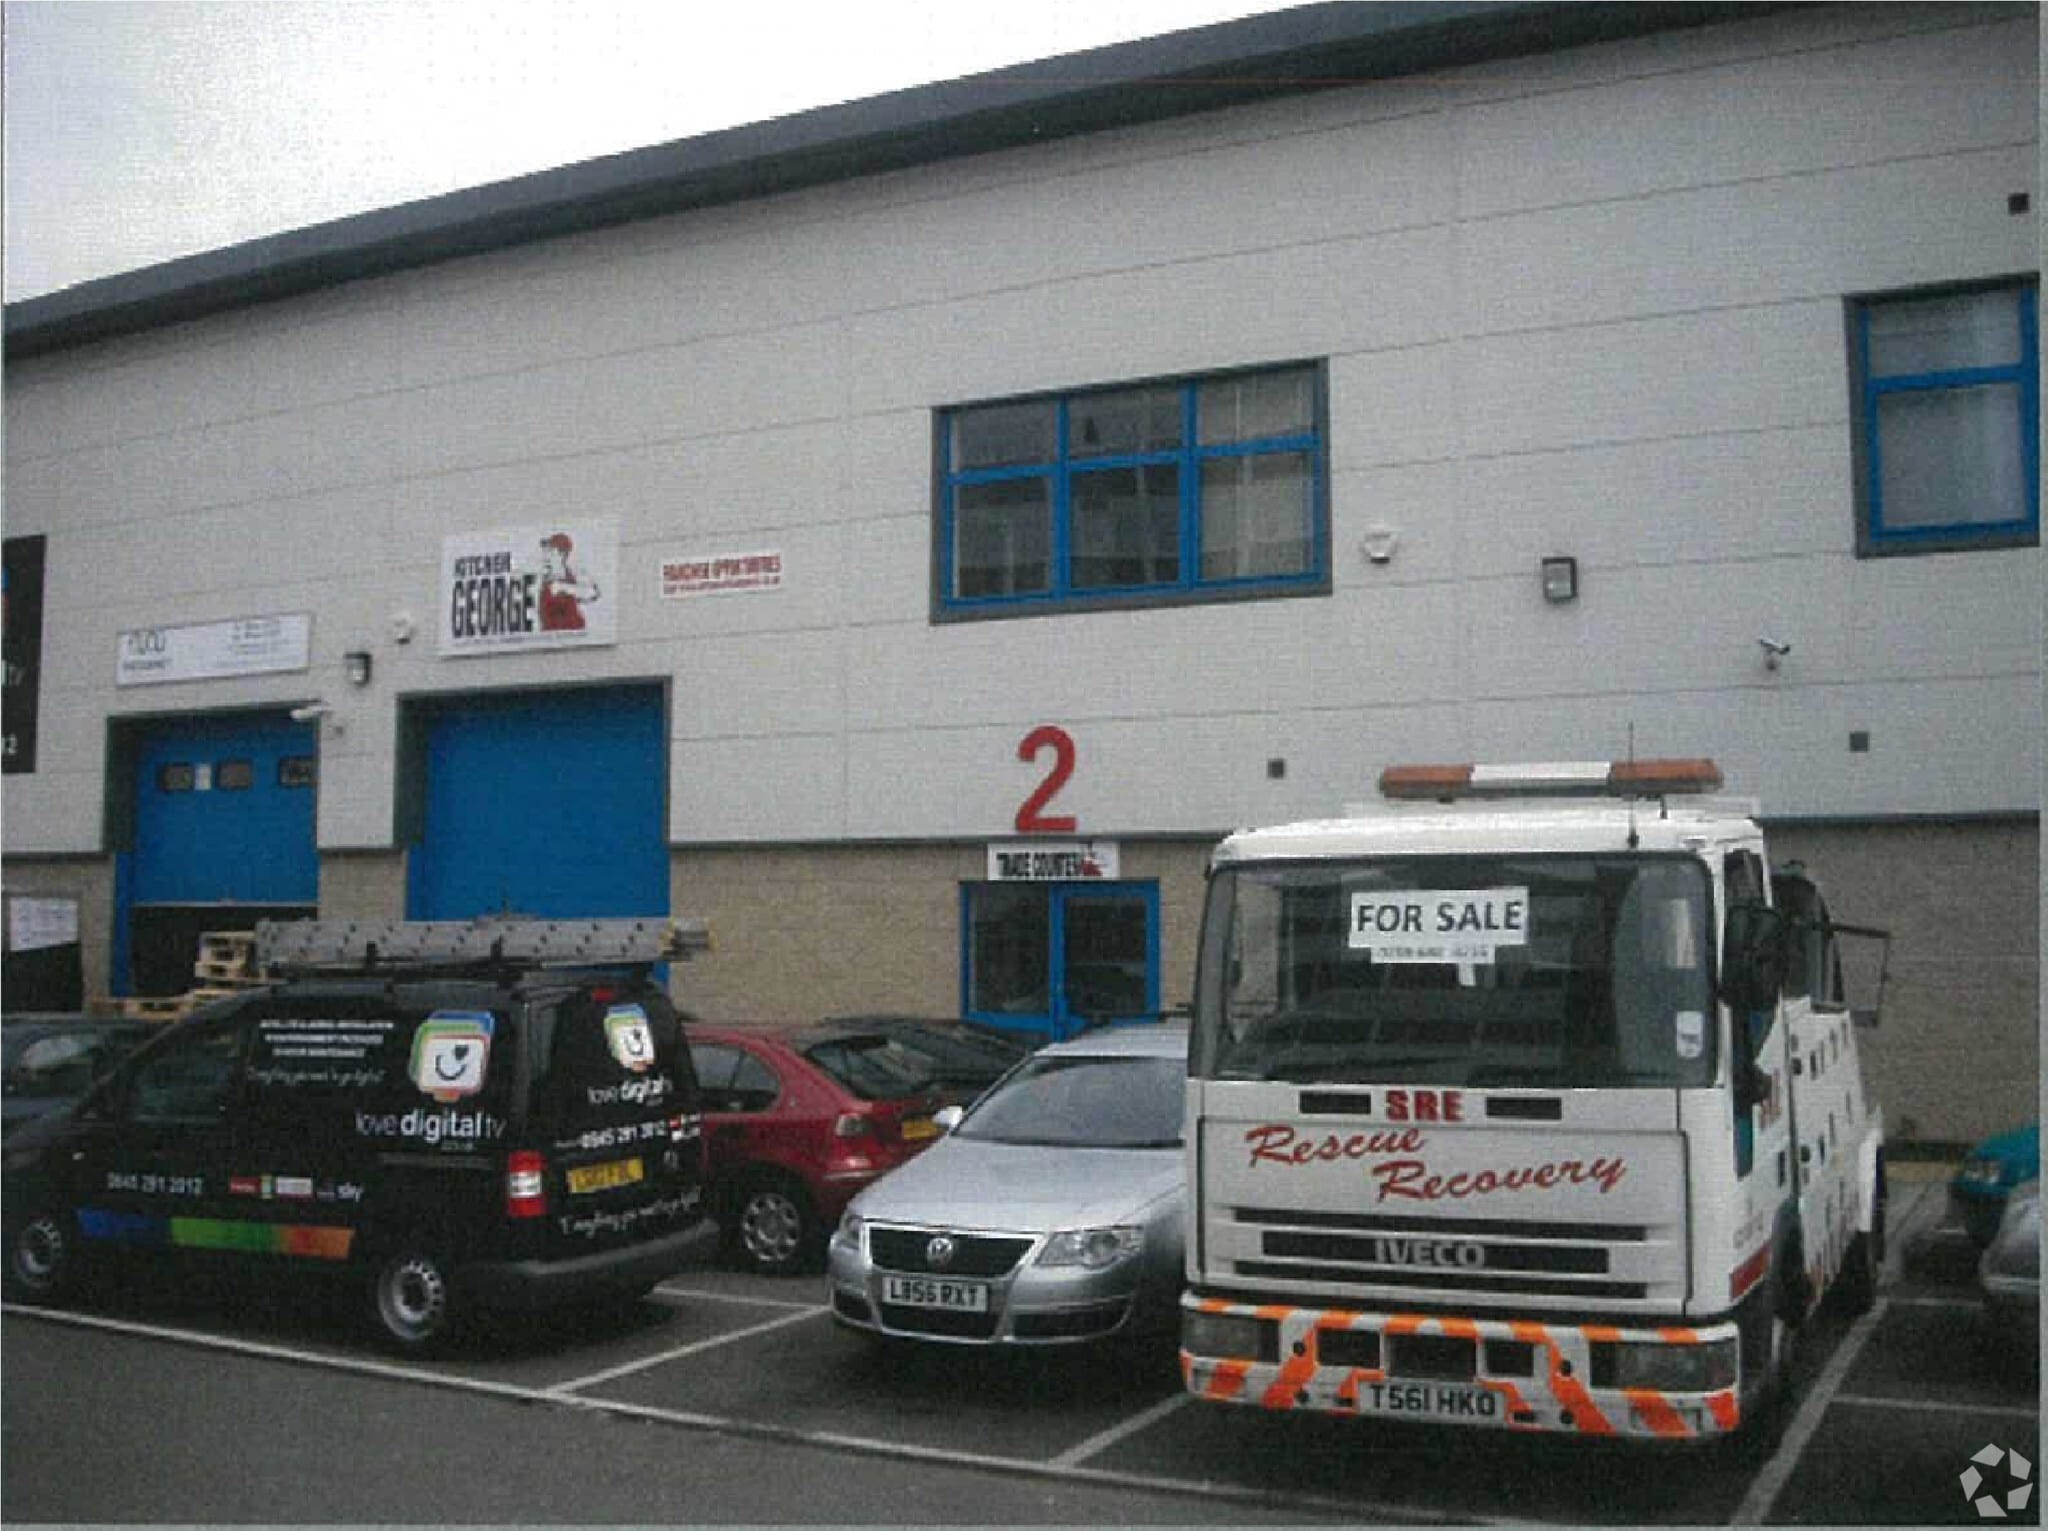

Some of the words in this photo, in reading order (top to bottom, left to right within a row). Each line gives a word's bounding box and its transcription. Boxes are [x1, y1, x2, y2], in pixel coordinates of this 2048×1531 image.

[453, 575, 536, 638] GEORGE
[1015, 725, 1076, 832] 2
[1357, 904, 1423, 932] FOR
[1436, 901, 1522, 932] SALE
[1384, 1090, 1465, 1123] SRE
[1246, 1124, 1429, 1168] Rescue
[1372, 1154, 1628, 1203] Recovery
[1375, 1239, 1486, 1267] IVECO
